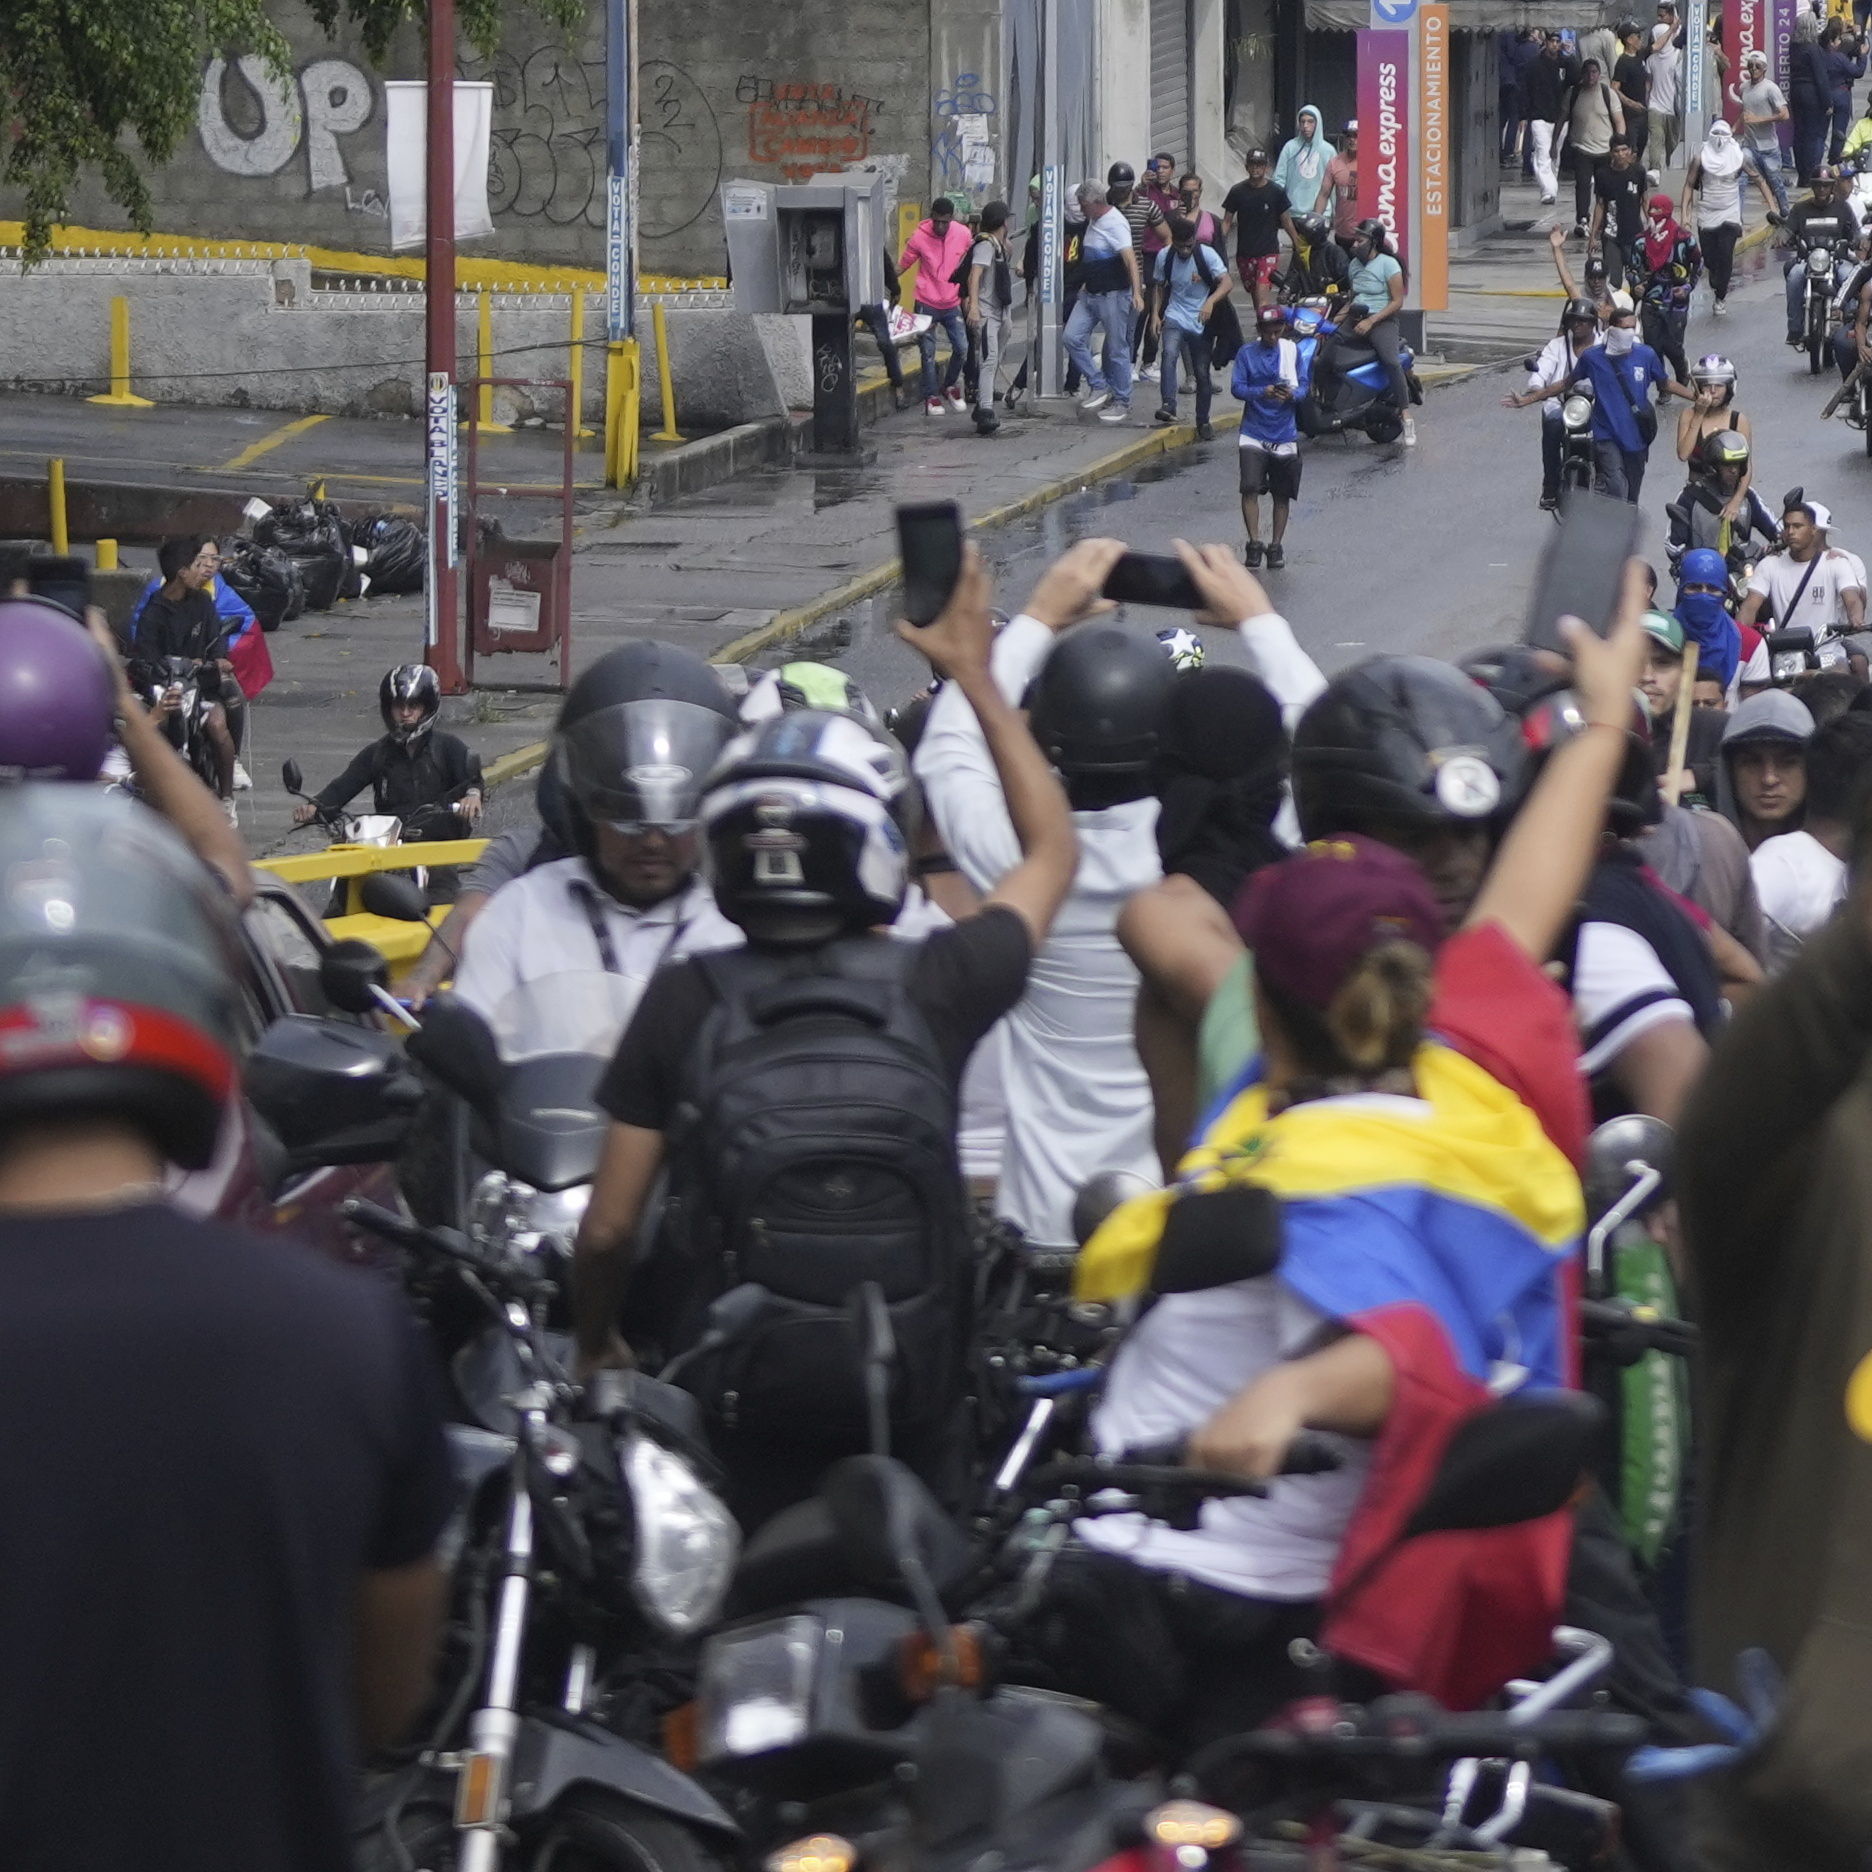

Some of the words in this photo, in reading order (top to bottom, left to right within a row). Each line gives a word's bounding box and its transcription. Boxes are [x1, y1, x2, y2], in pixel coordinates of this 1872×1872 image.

[1778, 7, 1791, 26] 24
[1378, 61, 1403, 155] express
[1425, 15, 1442, 216] ESTACIONAMIENTO
[612, 180, 621, 234] VOTA
[1045, 170, 1053, 216] VOTA
[611, 248, 620, 313] CONDE
[1043, 232, 1051, 290] CONDE
